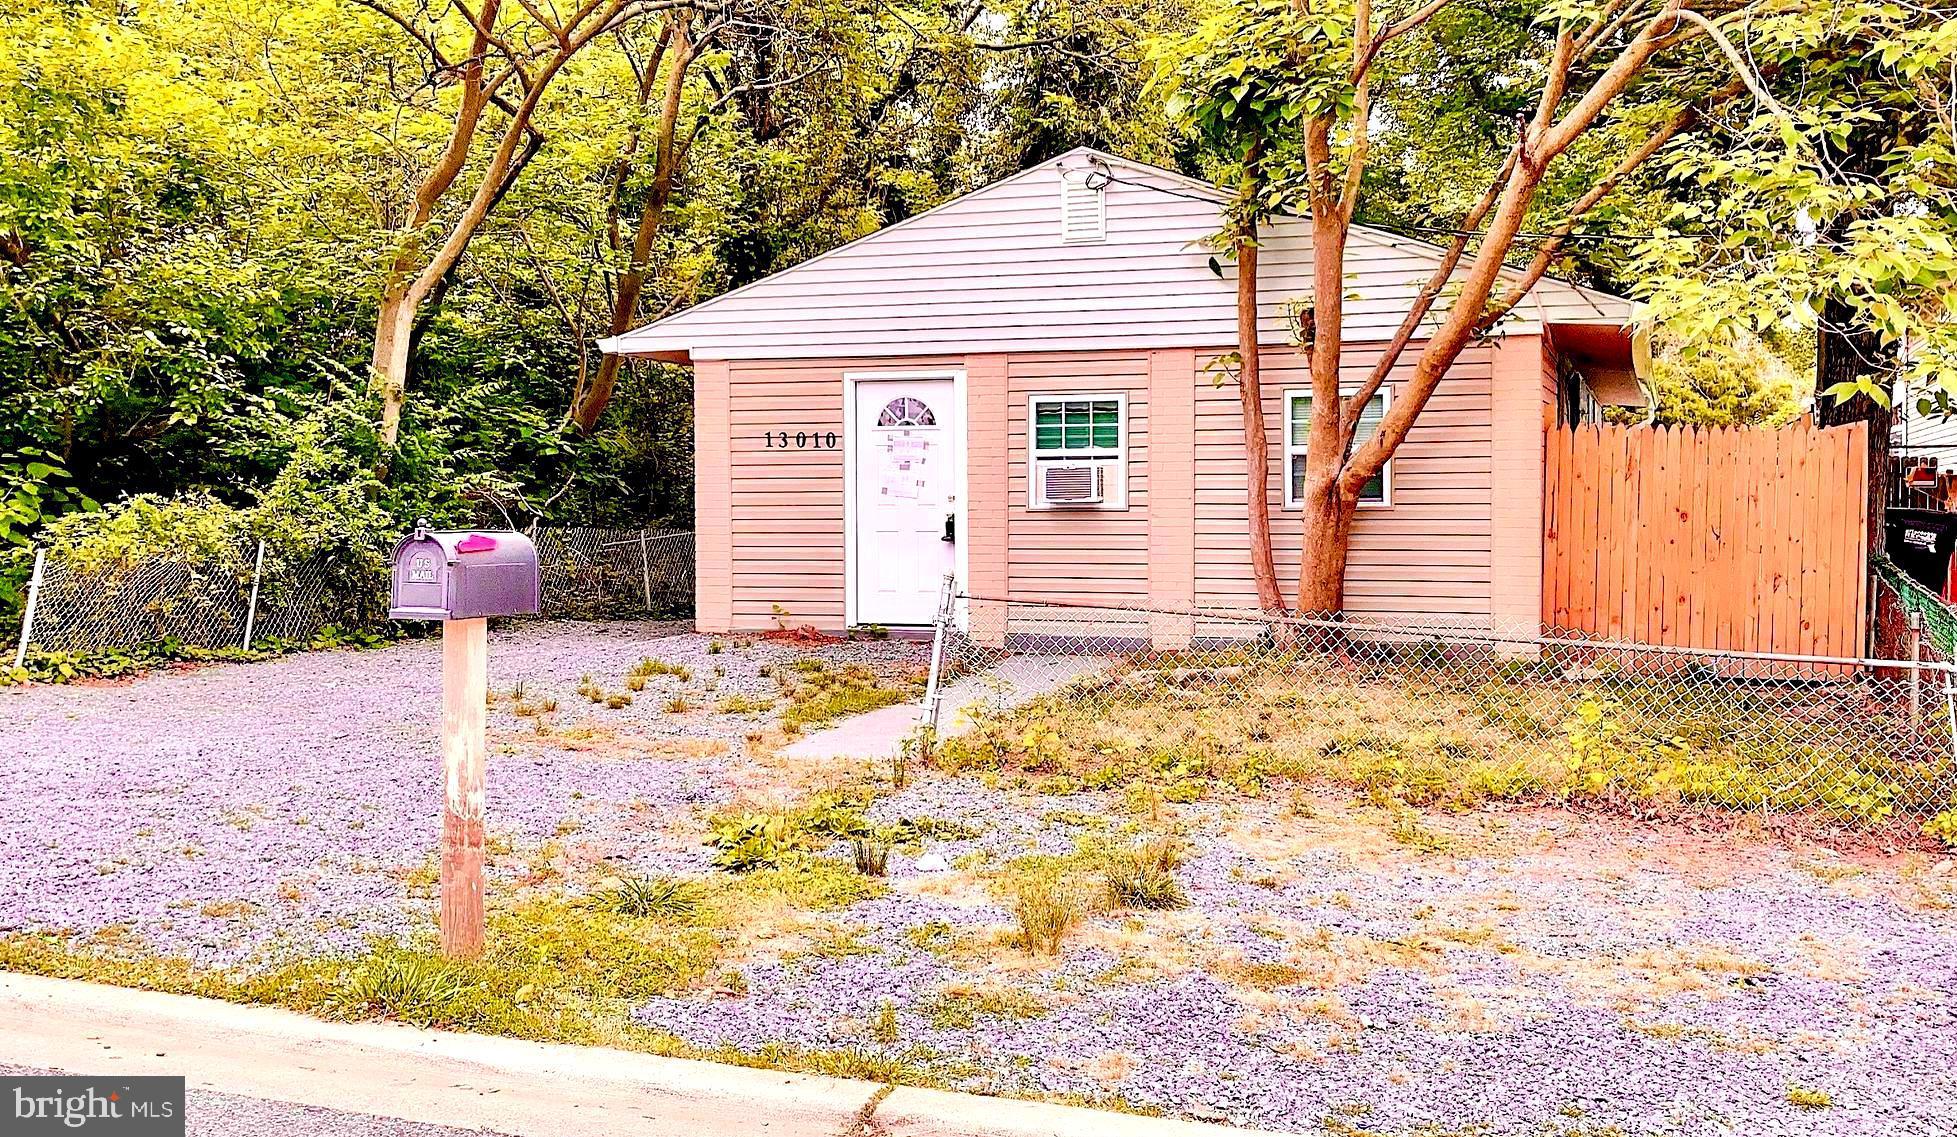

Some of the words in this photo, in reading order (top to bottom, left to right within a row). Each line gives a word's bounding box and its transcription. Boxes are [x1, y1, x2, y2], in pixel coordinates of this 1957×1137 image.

[765, 431, 837, 449] 13010
[416, 558, 431, 569] US
[411, 569, 434, 580] MAIL
